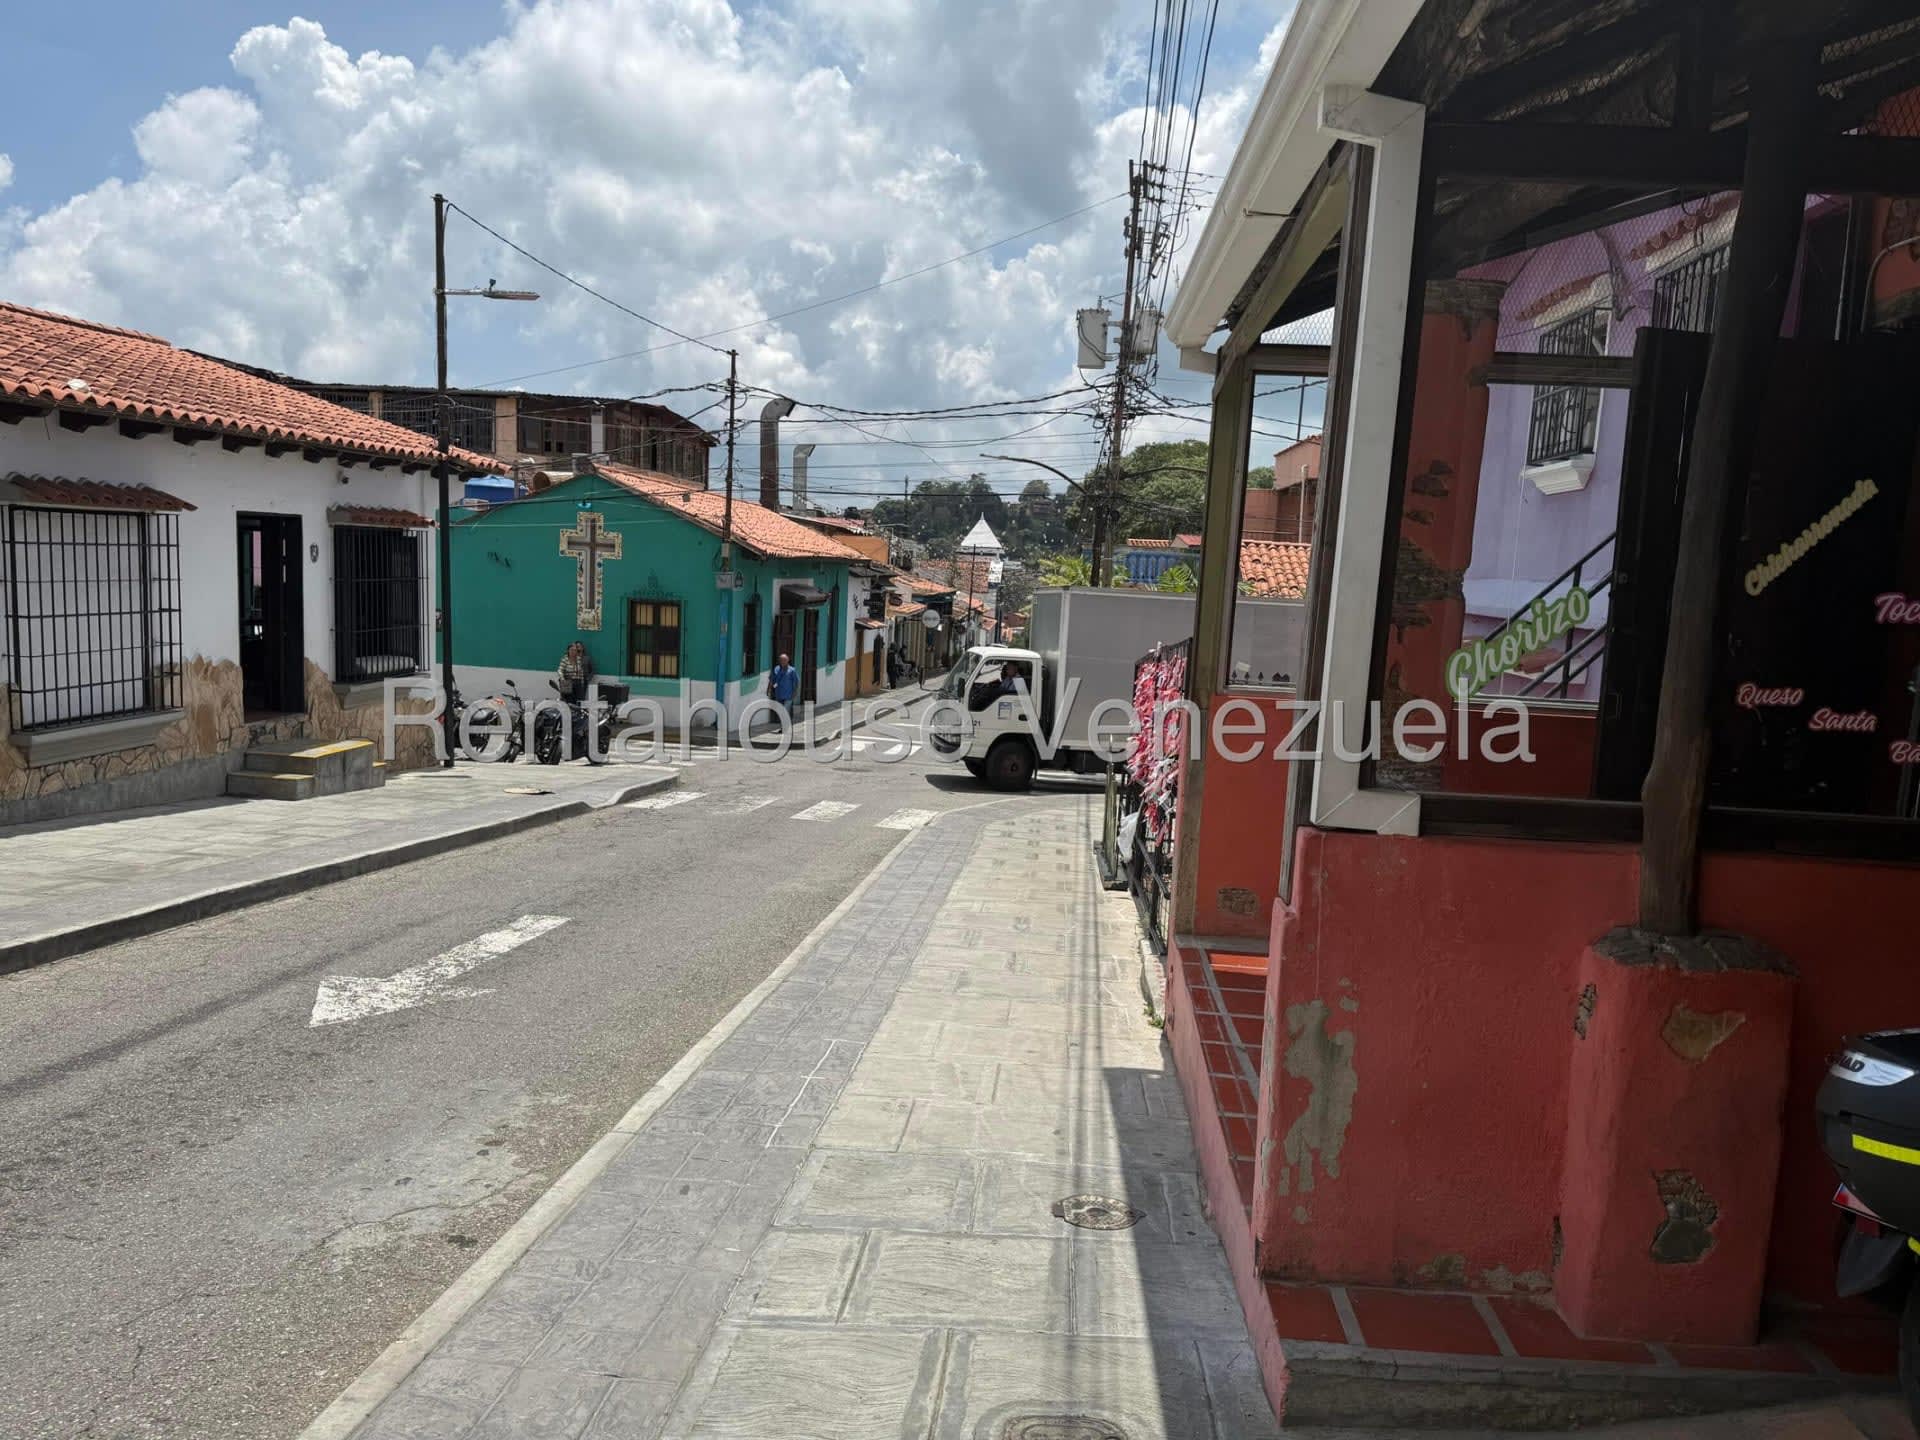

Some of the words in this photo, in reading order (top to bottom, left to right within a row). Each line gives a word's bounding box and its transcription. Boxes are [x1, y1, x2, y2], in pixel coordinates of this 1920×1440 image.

[1447, 587, 1589, 698] Chorizo
[1736, 683, 1804, 709] Queso
[1809, 708, 1877, 731] Santa
